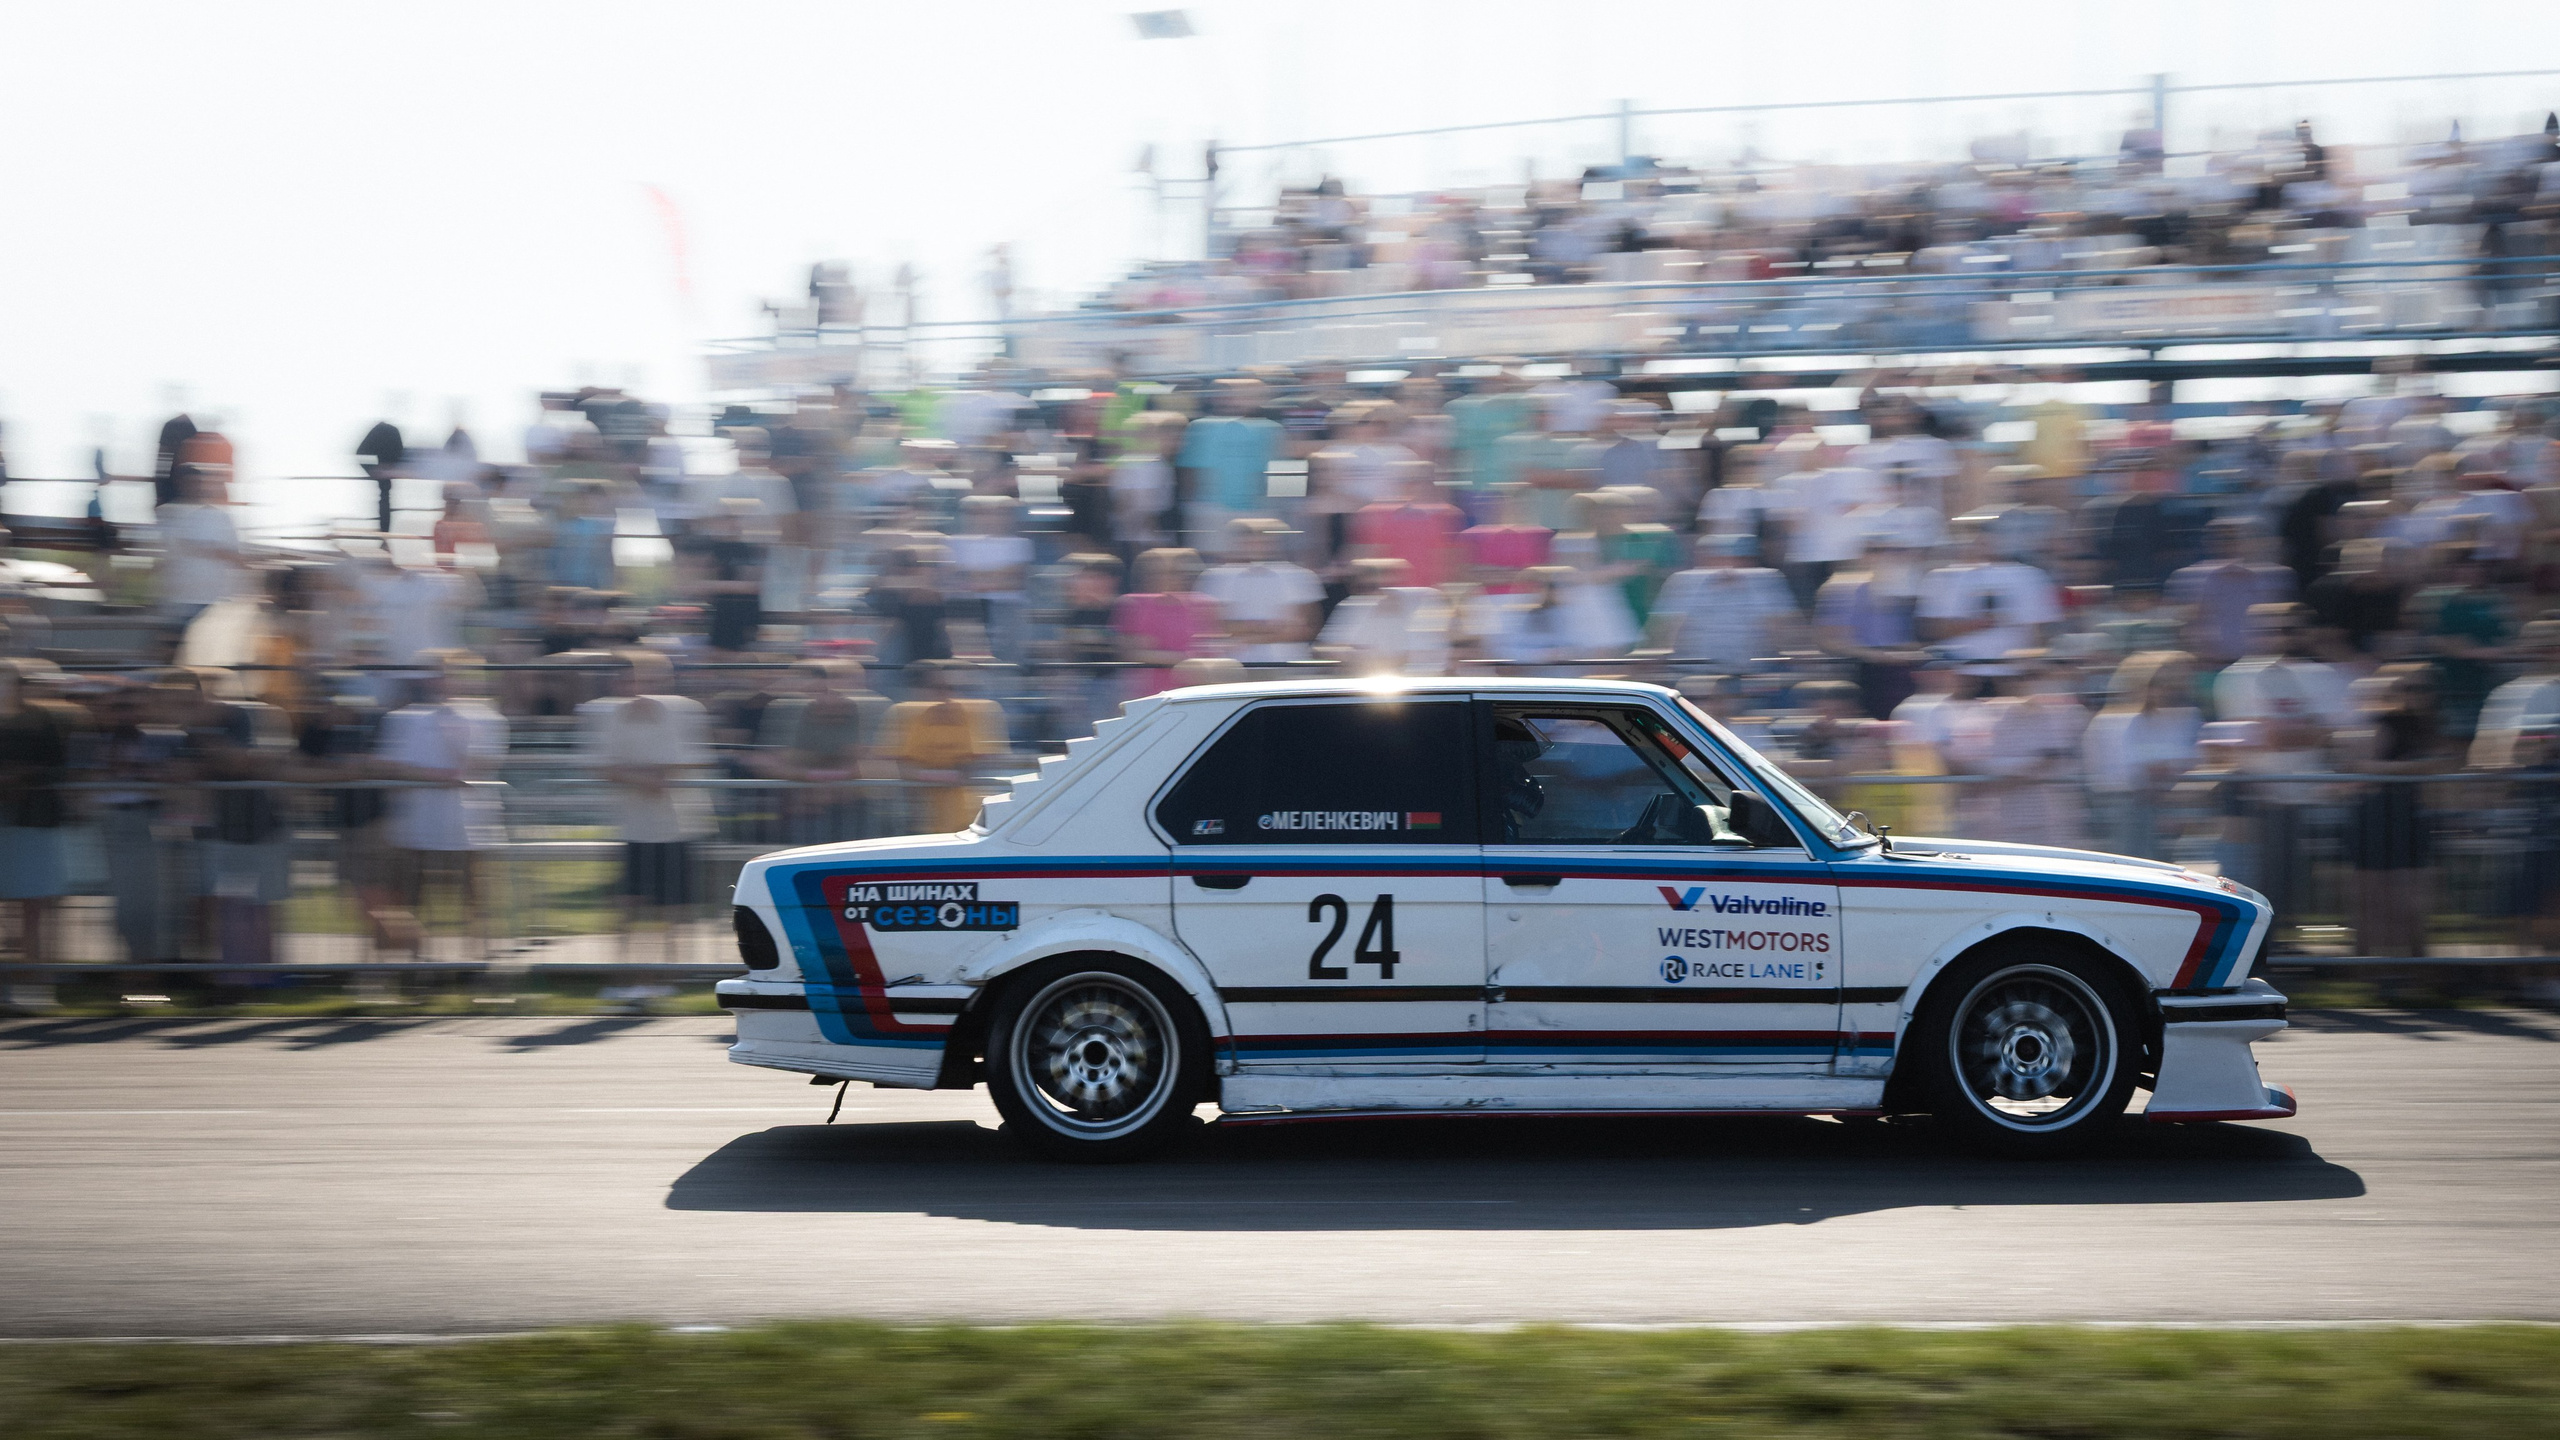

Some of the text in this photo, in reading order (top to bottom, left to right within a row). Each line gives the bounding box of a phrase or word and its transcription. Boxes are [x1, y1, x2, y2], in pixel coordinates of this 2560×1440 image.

[1272, 811, 1398, 830] МЕЛЕНКЕВИЧ
[848, 885, 974, 902] НА ШИНАХ
[1710, 894, 1826, 917] Valvoline
[1308, 893, 1400, 979] 24
[1658, 927, 1830, 952] WESTMOTORS
[1693, 963, 1744, 978] RACE
[1750, 964, 1804, 979] LANE
